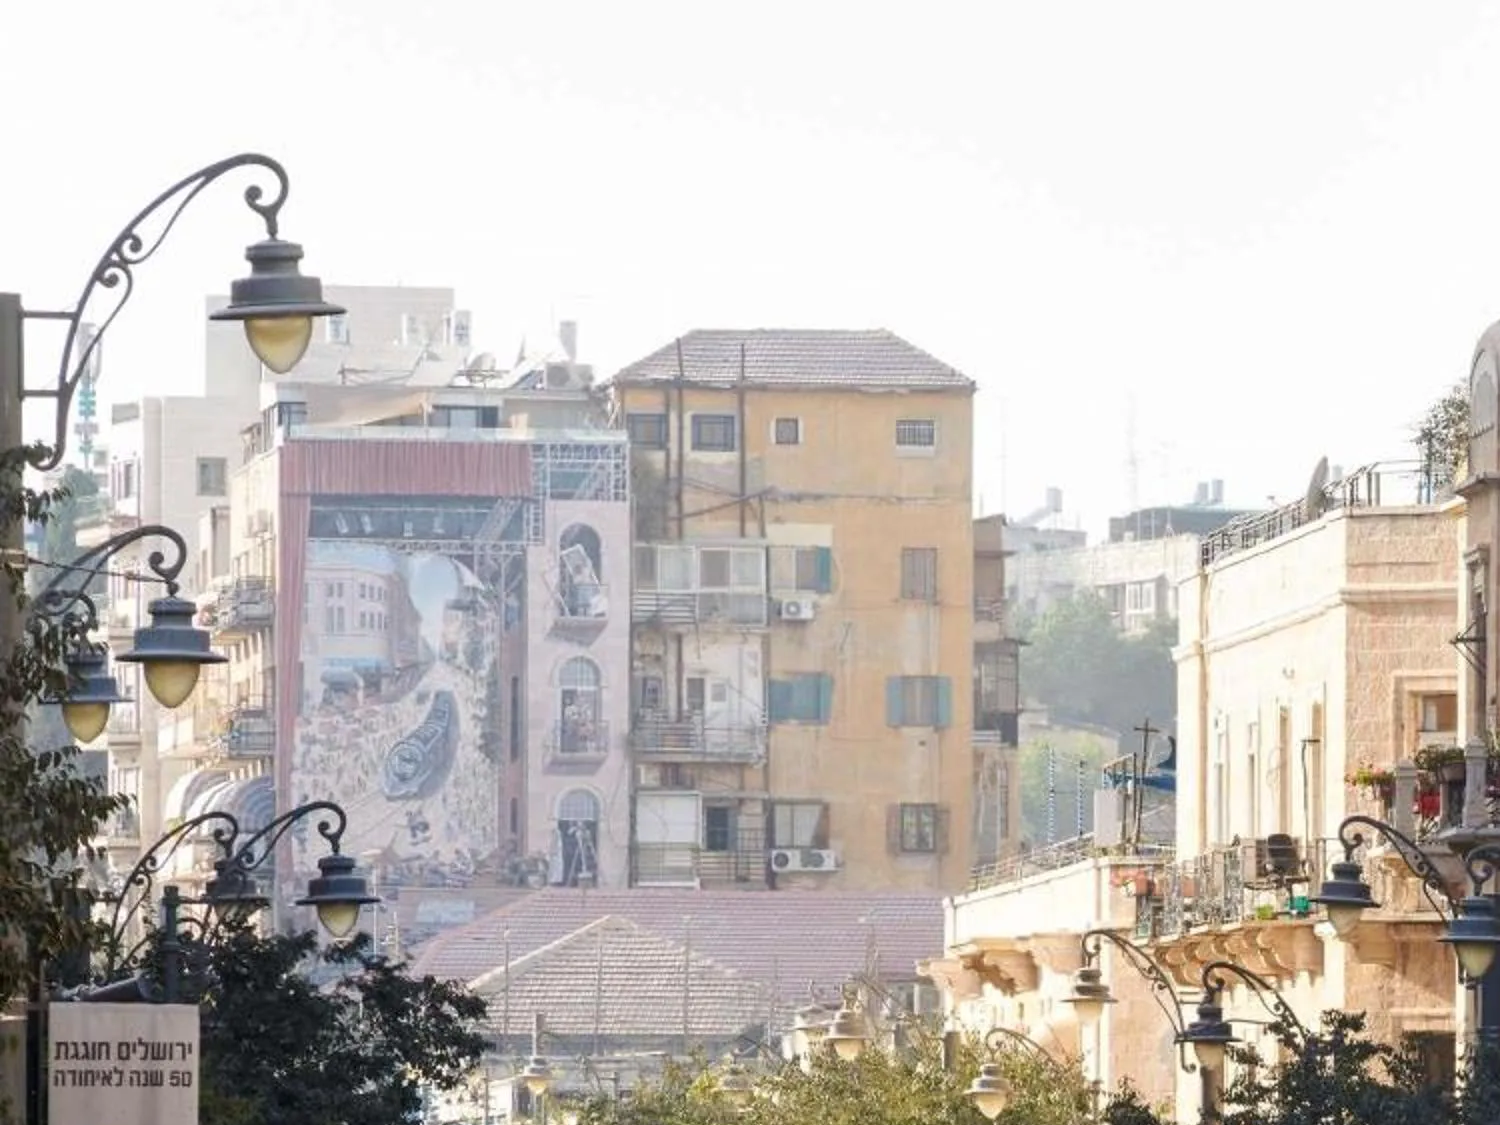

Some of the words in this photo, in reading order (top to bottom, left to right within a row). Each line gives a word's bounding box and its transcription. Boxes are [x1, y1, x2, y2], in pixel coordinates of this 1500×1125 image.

[54, 1041, 110, 1061] חוגגת
[117, 1037, 193, 1061] ירושלים
[53, 1066, 125, 1087] לאיחודה
[129, 1069, 164, 1087] שנה
[169, 1070, 193, 1087] 50
